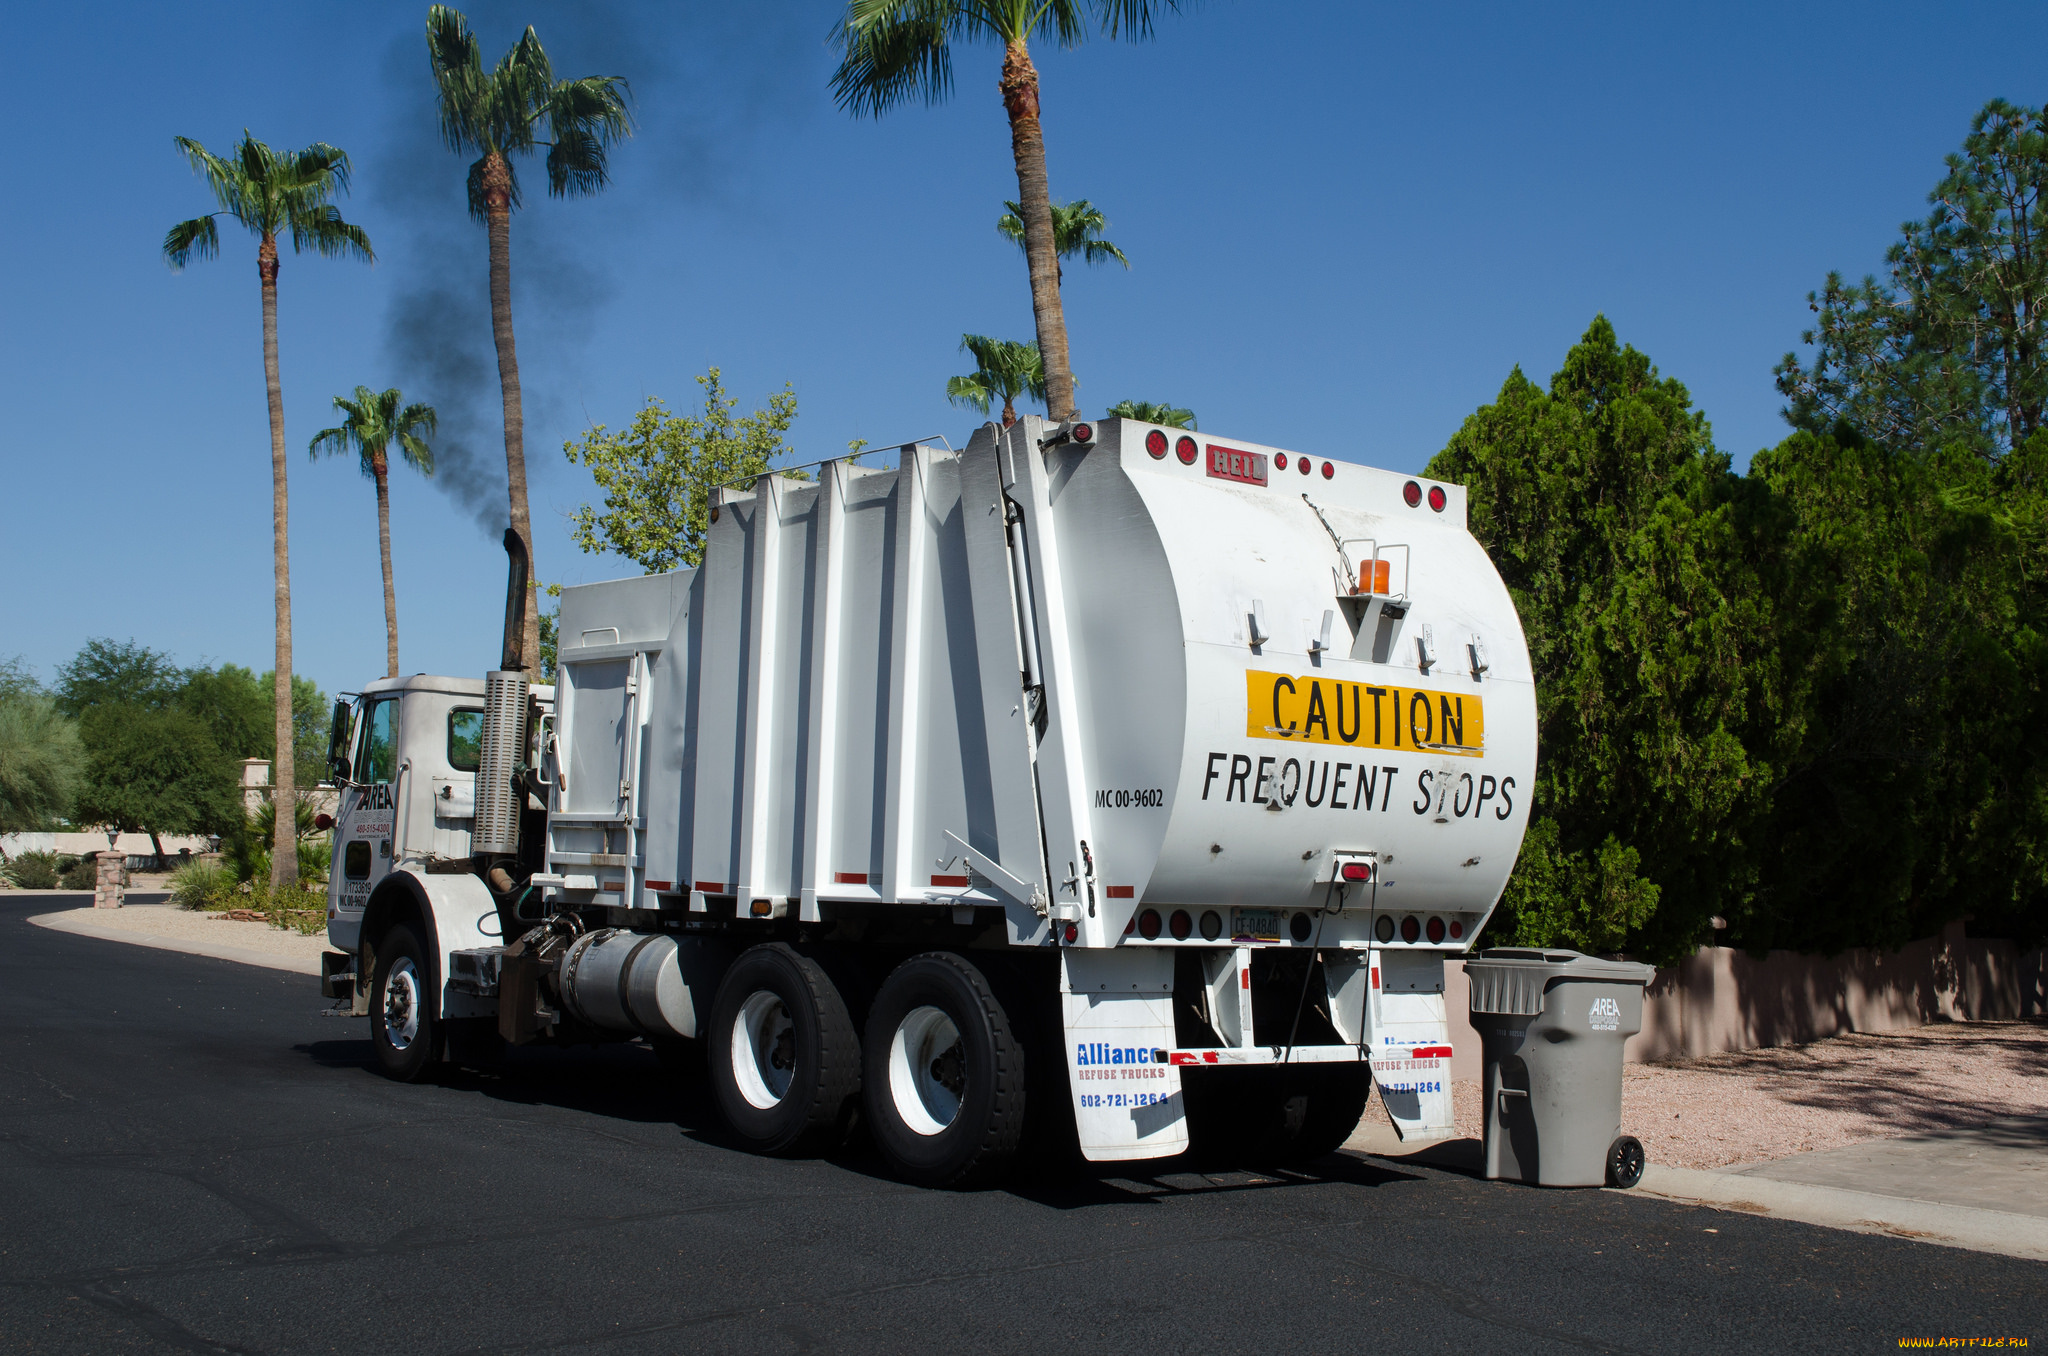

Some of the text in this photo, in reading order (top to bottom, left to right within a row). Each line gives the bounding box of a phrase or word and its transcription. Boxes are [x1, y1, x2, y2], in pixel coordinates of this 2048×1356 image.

[1272, 676, 1463, 749] CAUTION
[1202, 752, 1398, 811] FREQUENT
[356, 784, 394, 810] AREA
[1094, 788, 1163, 808] MC 00-9602
[1413, 769, 1516, 820] STOPS
[1589, 998, 1621, 1017] AREA
[1079, 1068, 1165, 1081] REFUSE TRUCKS
[1404, 1059, 1440, 1070] TRUCKS
[1081, 1093, 1169, 1107] 602-721-1264
